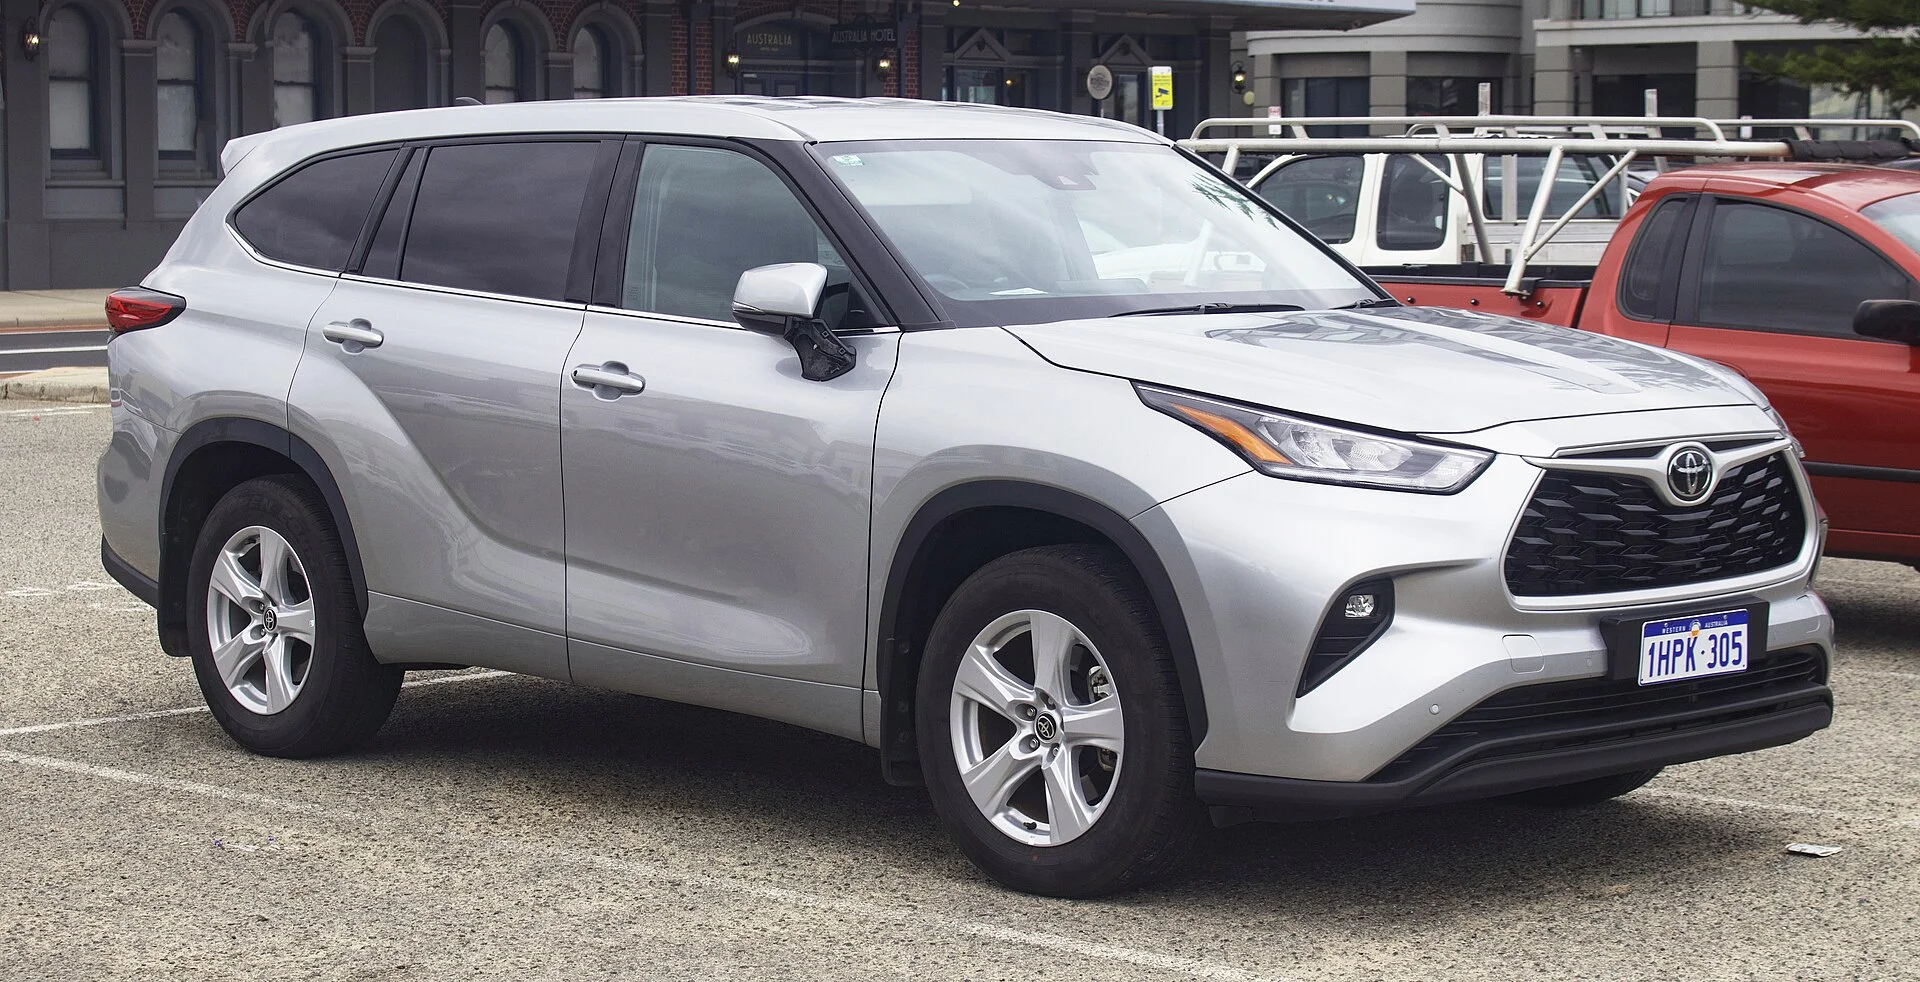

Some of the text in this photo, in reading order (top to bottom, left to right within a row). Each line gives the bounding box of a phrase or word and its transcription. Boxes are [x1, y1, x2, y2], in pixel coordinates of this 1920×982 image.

[746, 33, 792, 46] AUSTRALIA
[832, 28, 896, 43] AUSTRALIA HOTEL
[1662, 619, 1729, 634] WESTERN AUSTRALIA
